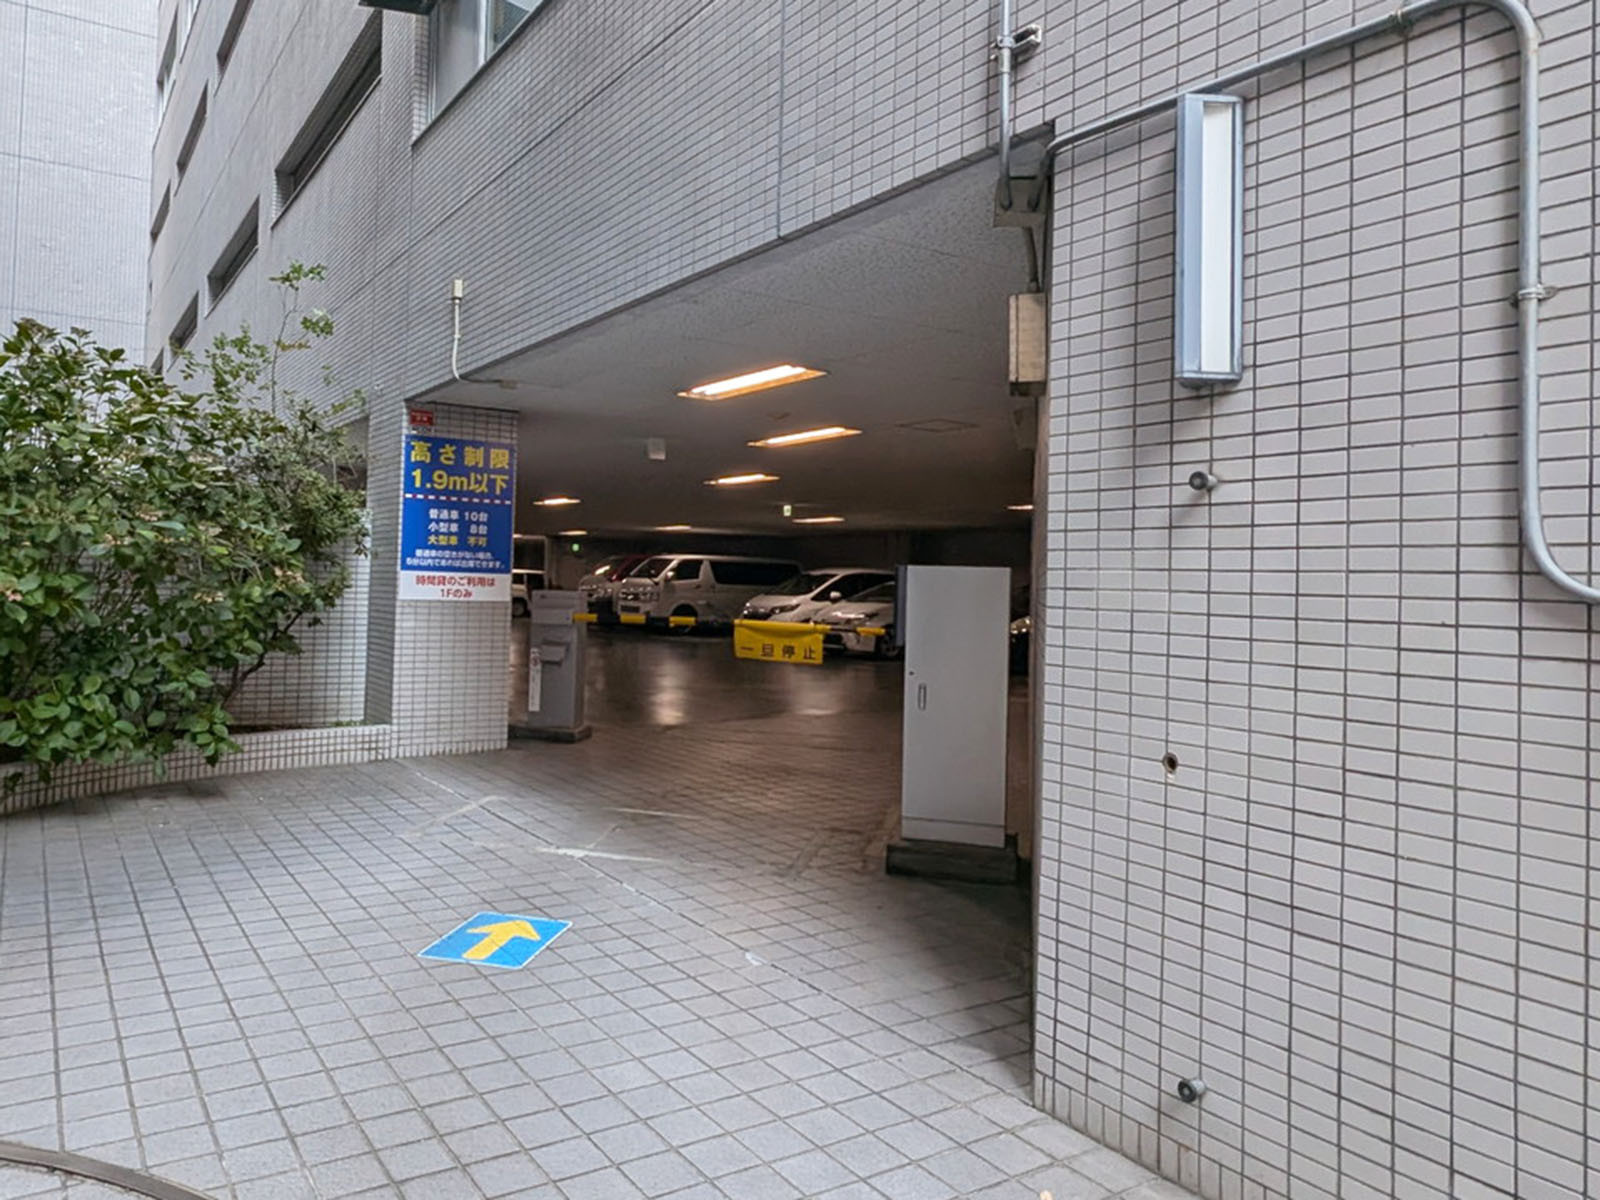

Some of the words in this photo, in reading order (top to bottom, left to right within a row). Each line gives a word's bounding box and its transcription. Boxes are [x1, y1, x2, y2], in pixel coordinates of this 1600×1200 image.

[411, 440, 510, 469] 高さ制限
[412, 468, 509, 495] 1.9m以下
[428, 521, 459, 532] 小型車
[428, 534, 458, 545] 大型車
[467, 536, 487, 547] 不可
[415, 575, 495, 587] 時間貸のご利用は
[440, 588, 473, 599] 1Fのみ
[740, 643, 816, 659] 一旦停止
